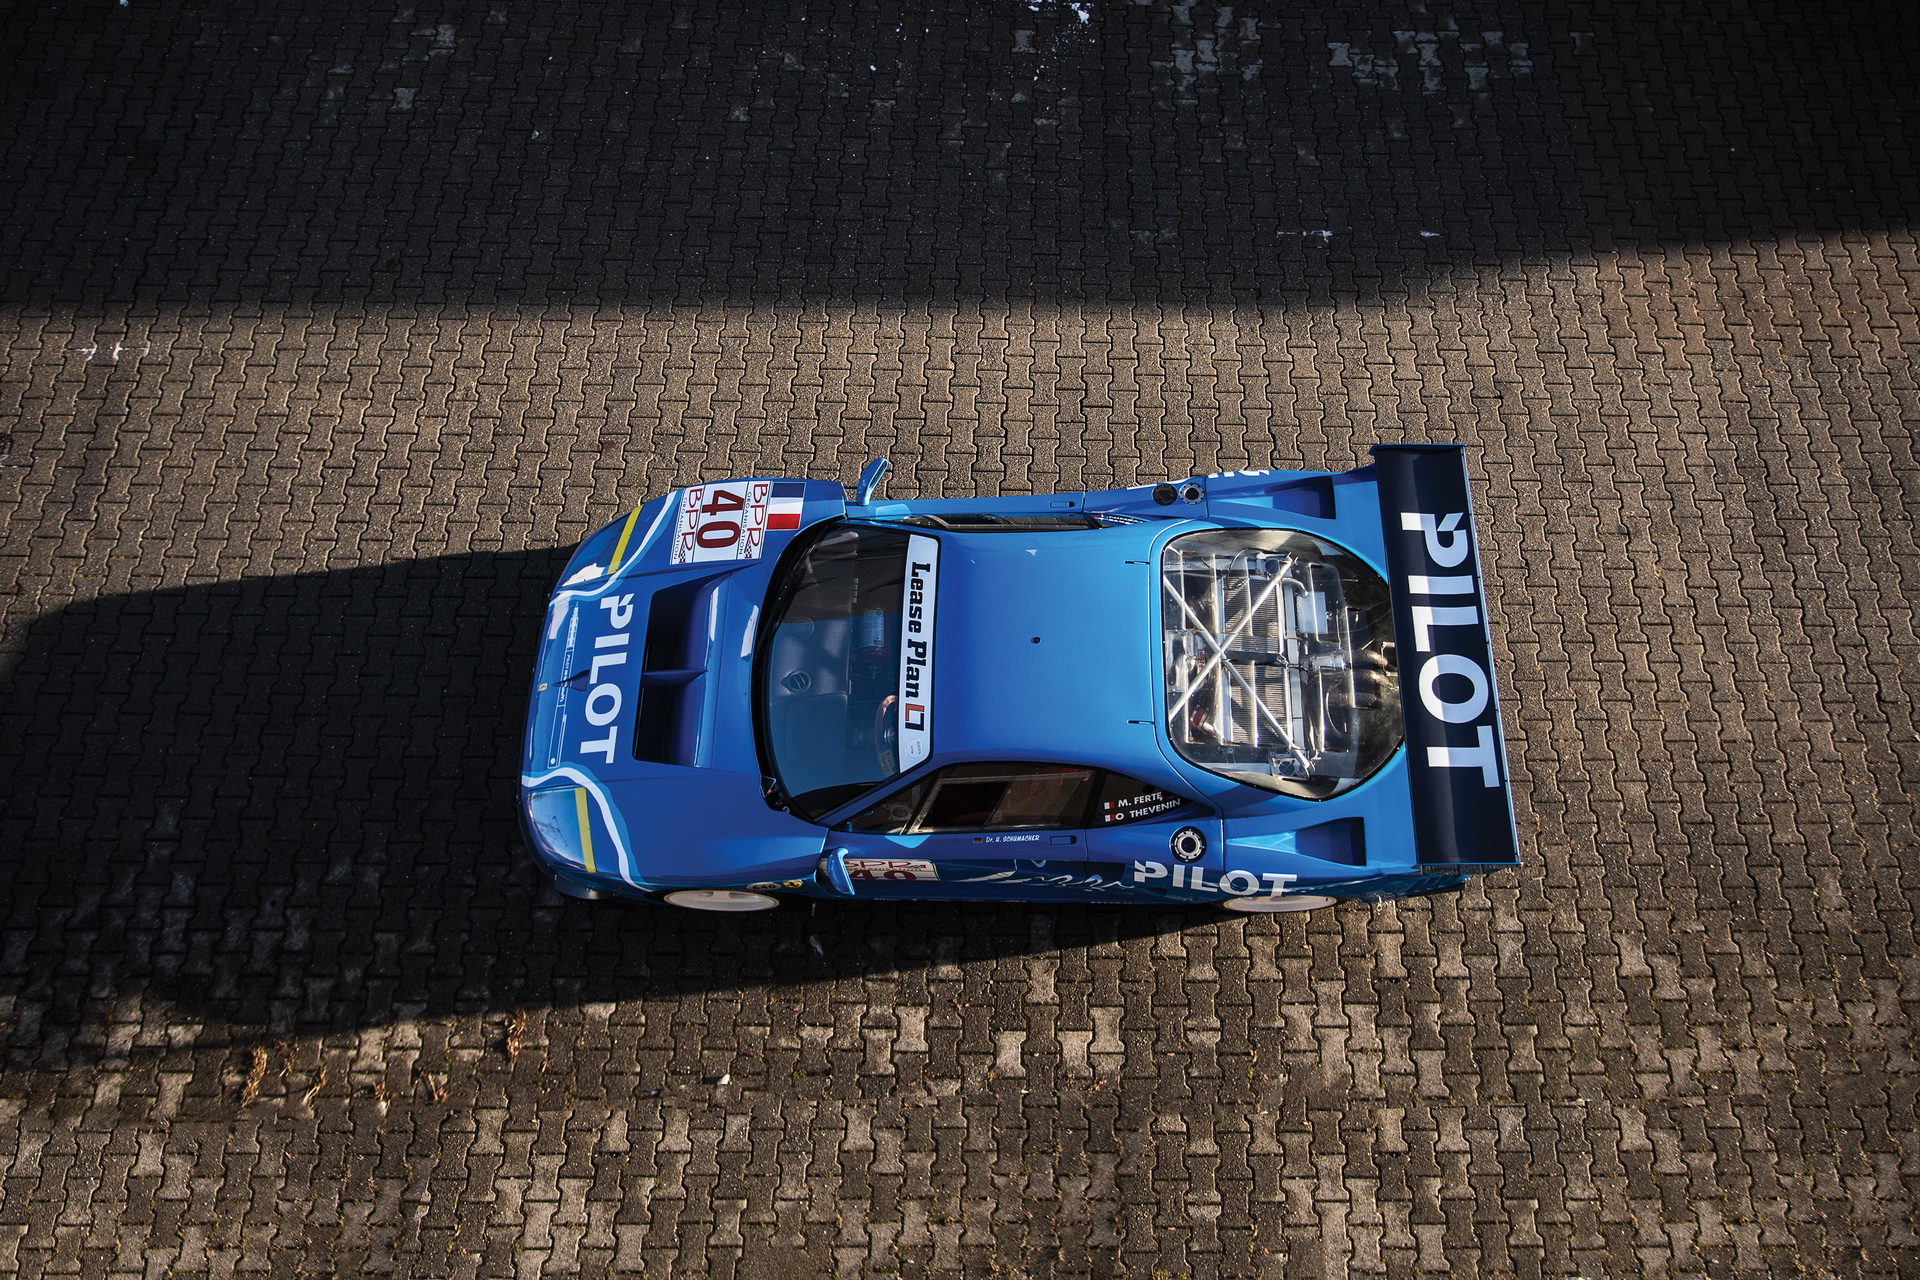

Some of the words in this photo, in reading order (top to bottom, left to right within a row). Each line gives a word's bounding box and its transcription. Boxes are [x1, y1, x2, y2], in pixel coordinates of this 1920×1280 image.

[673, 497, 687, 560] ORGANISATION
[678, 488, 703, 558] BPR
[696, 489, 745, 548] 40
[738, 491, 752, 555] ORGANISATION
[744, 483, 769, 556] BPR
[908, 561, 931, 634] Lease
[579, 592, 634, 764] PILOT
[905, 638, 927, 699] Plan
[1400, 511, 1500, 788] PILOT
[1115, 812, 1125, 821] O
[1129, 798, 1181, 818] THEVENIN
[1117, 798, 1132, 808] M.
[1133, 859, 1298, 897] PILOT
